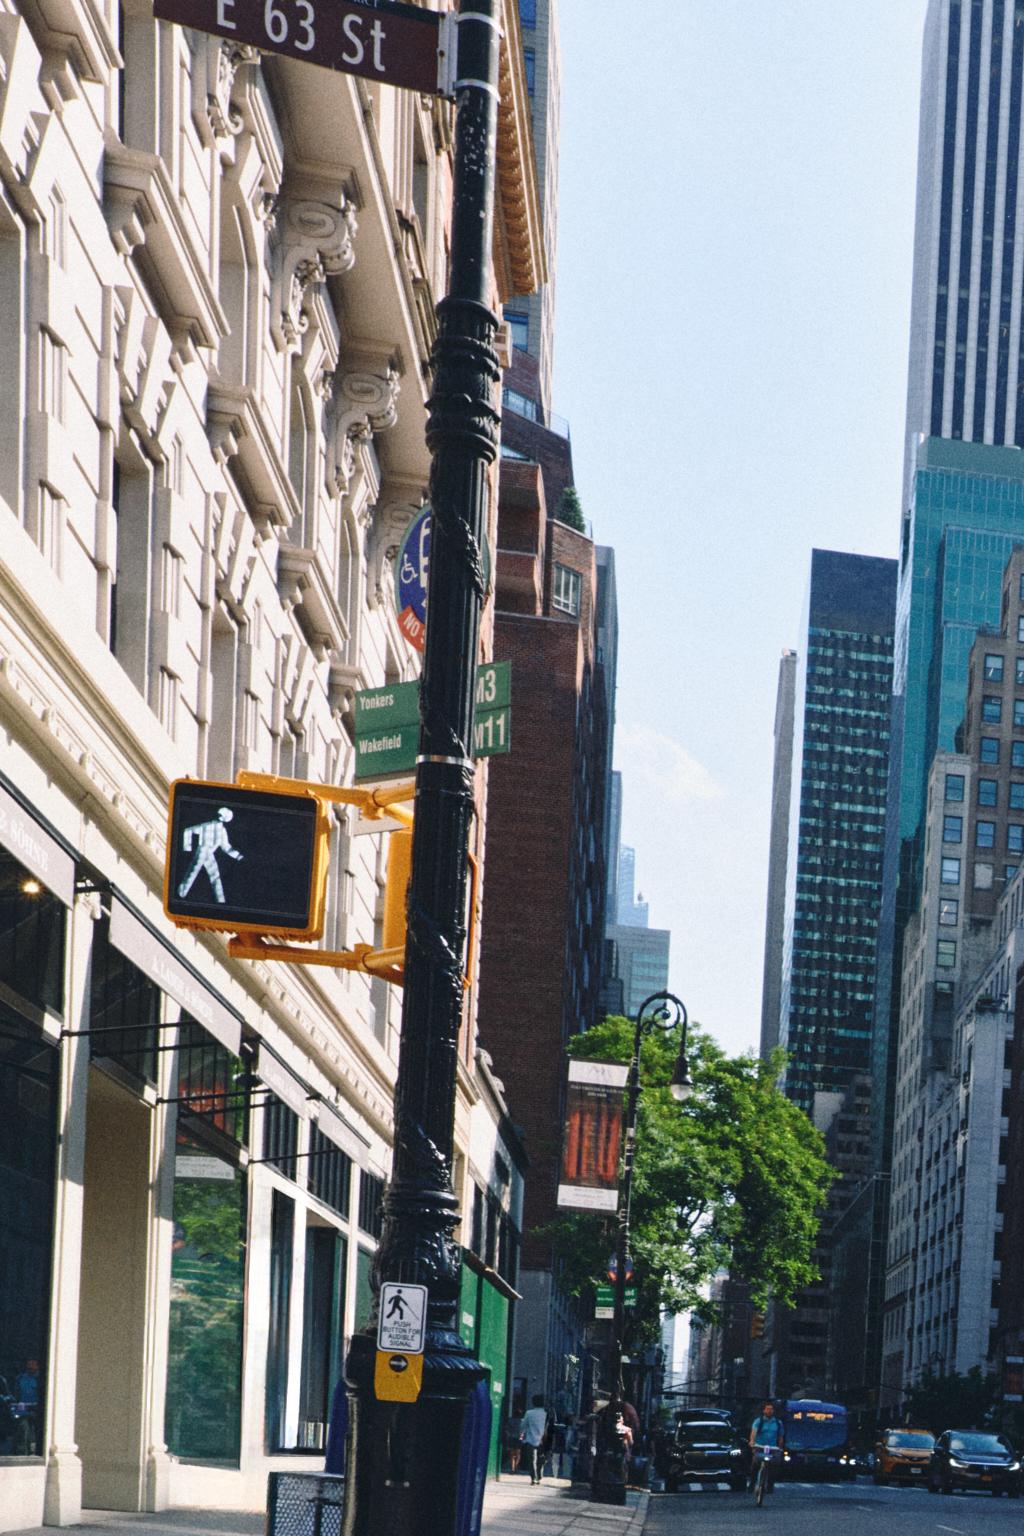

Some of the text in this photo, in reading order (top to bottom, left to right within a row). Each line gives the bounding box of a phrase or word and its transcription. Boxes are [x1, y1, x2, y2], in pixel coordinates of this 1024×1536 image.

[217, 0, 386, 73] E 63 St
[404, 613, 420, 637] NO
[360, 693, 394, 710] Yonkers
[359, 733, 402, 755] Wakefield
[388, 1333, 415, 1341] AUDIBLE
